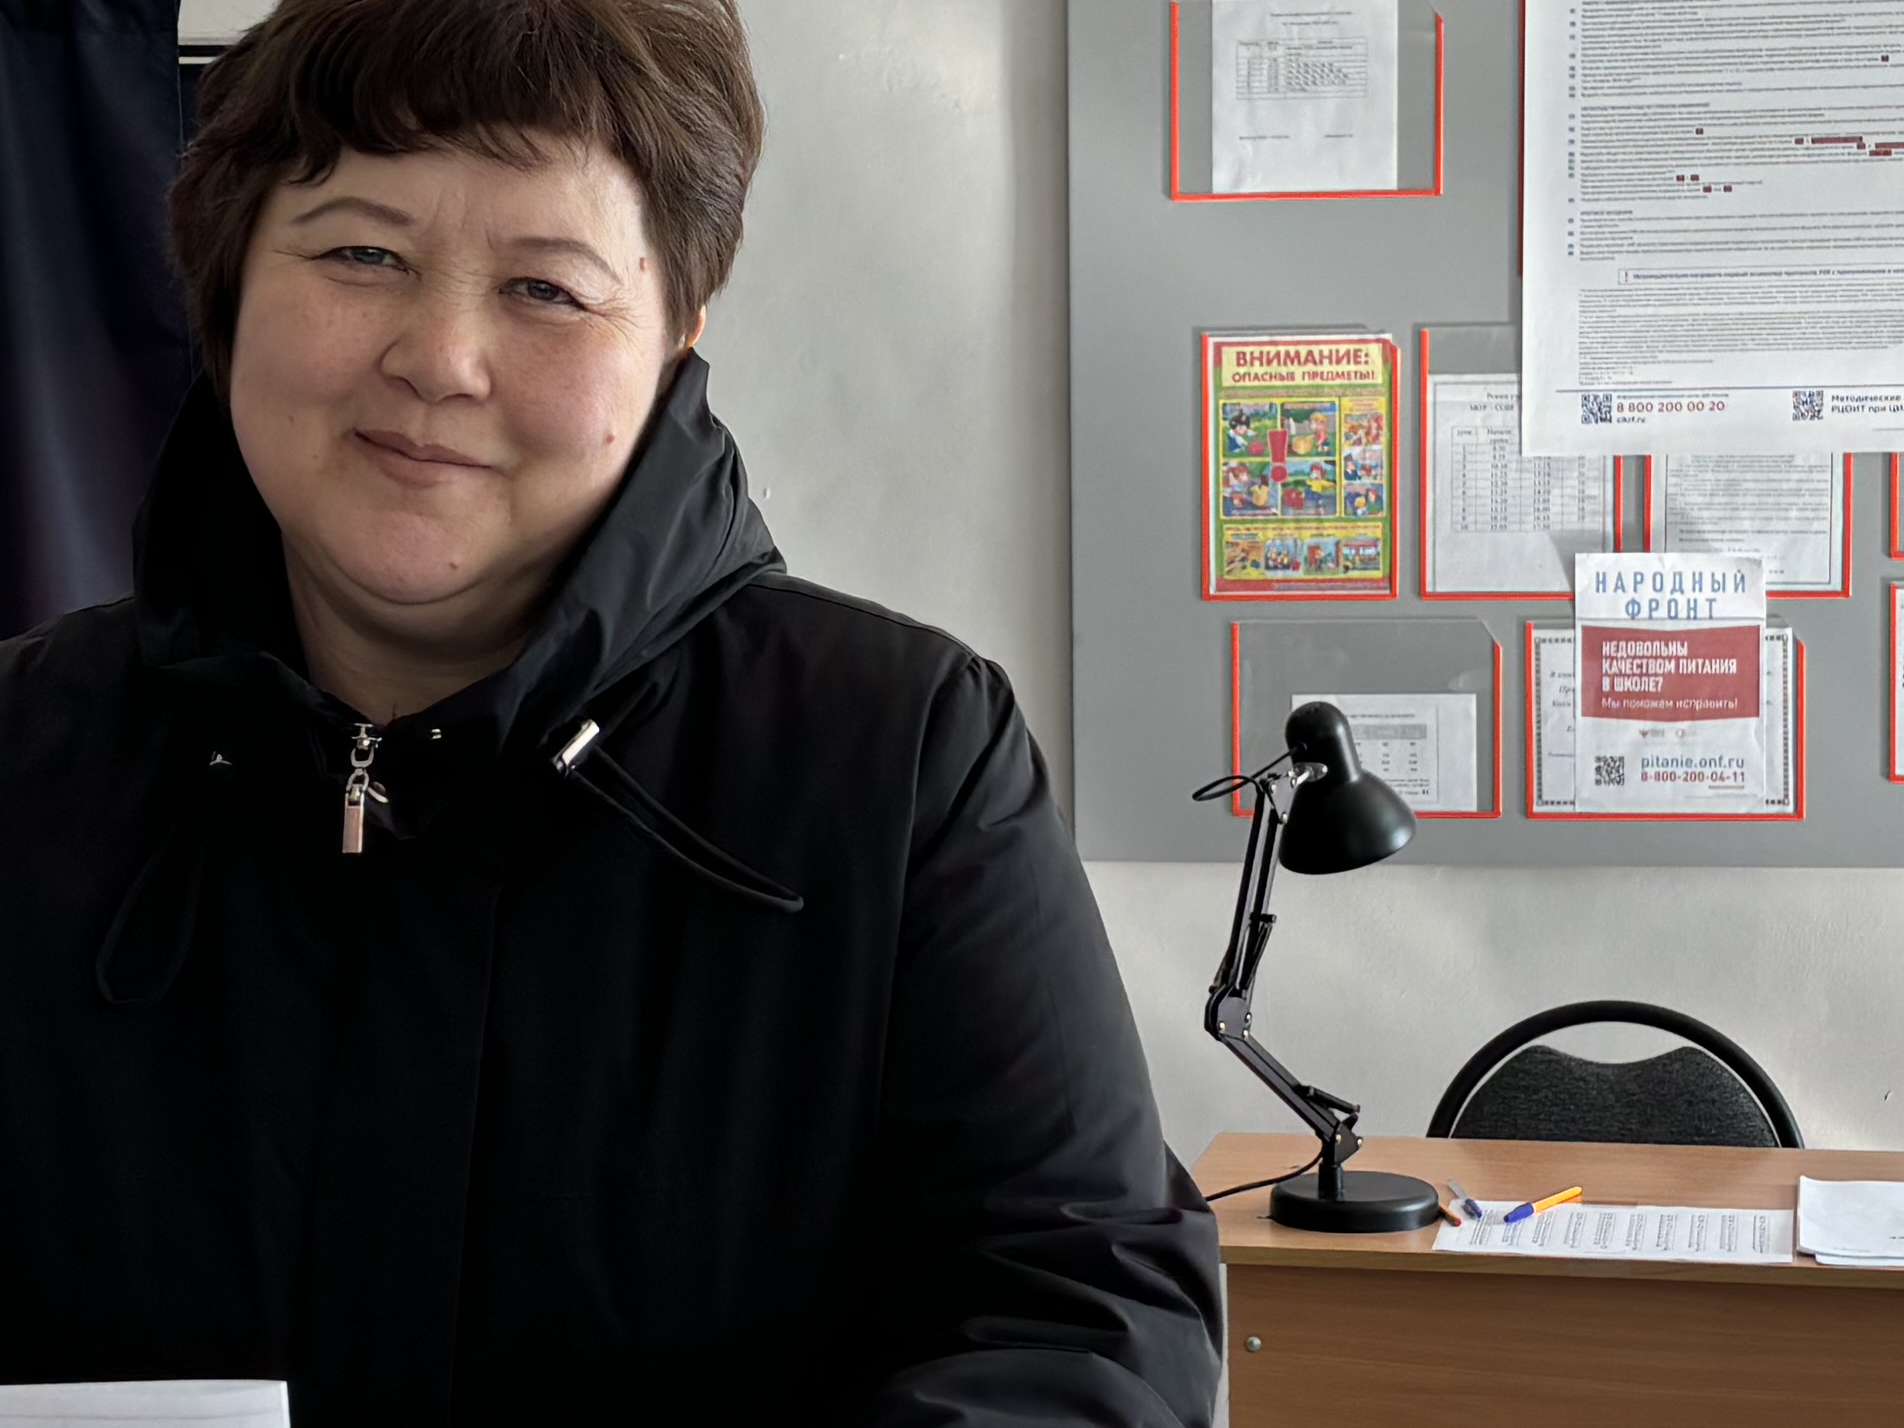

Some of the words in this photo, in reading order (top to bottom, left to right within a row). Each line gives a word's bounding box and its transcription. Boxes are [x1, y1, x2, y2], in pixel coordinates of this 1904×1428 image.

[1236, 348, 1370, 368] ВНИМАНИЕ:
[1231, 372, 1296, 383] ОПАСНЫЕ
[1302, 370, 1376, 382] ПРЕДМЕТЫ!
[1617, 402, 1624, 413] 8
[1628, 402, 1653, 413] 800
[1658, 401, 1682, 413] 200
[1687, 400, 1705, 412] 00
[1709, 400, 1725, 412] 20
[1595, 570, 1747, 595] НАРОДНЫЙ
[1625, 598, 1717, 620] ФРОНТ
[1602, 641, 1688, 658] НЕДОВОЛЬНЫ
[1602, 658, 1675, 675] КАЧЕСТВОМ
[1679, 658, 1737, 675] ПИТАНИЯ
[1602, 676, 1610, 692] В
[1614, 676, 1663, 693] ШКОЛЕ?
[1602, 698, 1620, 709] Мы
[1623, 699, 1673, 710] поможем
[1675, 697, 1738, 711] исправить!
[1641, 755, 1745, 771] pitanie.onf.ru
[1641, 771, 1745, 783] 8-800-200-04-11
